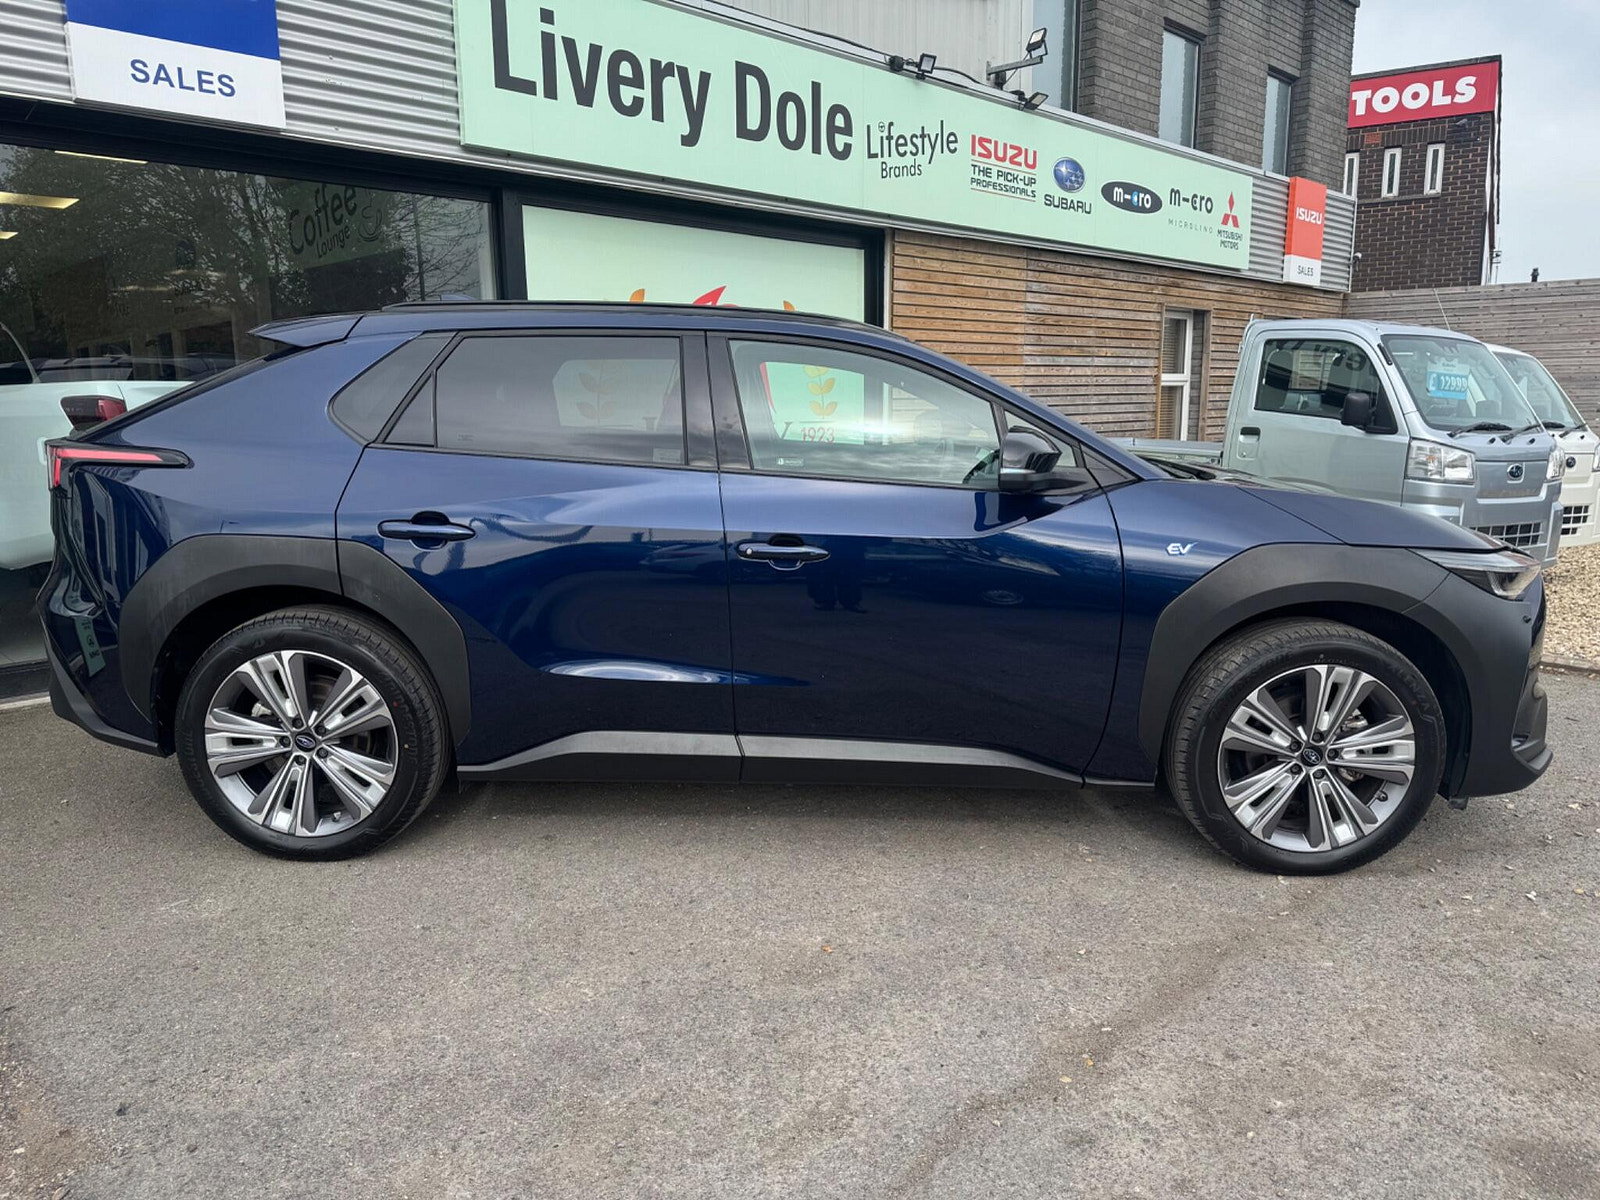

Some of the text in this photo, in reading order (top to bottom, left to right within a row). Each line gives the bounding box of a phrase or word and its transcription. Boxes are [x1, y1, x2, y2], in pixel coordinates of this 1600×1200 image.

[130, 58, 236, 97] SALES
[490, 0, 853, 160] Livery Dole
[1352, 75, 1477, 116] TOOLS
[866, 120, 958, 164] Lifestyle
[971, 134, 1037, 170] ISUZU
[880, 158, 922, 179] Brands
[971, 164, 1036, 187] THE PICK-UP
[970, 177, 1036, 198] PROFESSIONALS
[1044, 193, 1092, 214] SUBARU
[289, 184, 357, 255] Coffee
[1168, 218, 1213, 234] MICROLINO
[1295, 206, 1323, 225] ISUZU
[316, 225, 351, 258] Lounge
[1217, 229, 1243, 241] MITSUBISHI
[1220, 239, 1239, 251] MOTORS
[1297, 265, 1314, 277] SALES
[1166, 542, 1199, 554] EV
